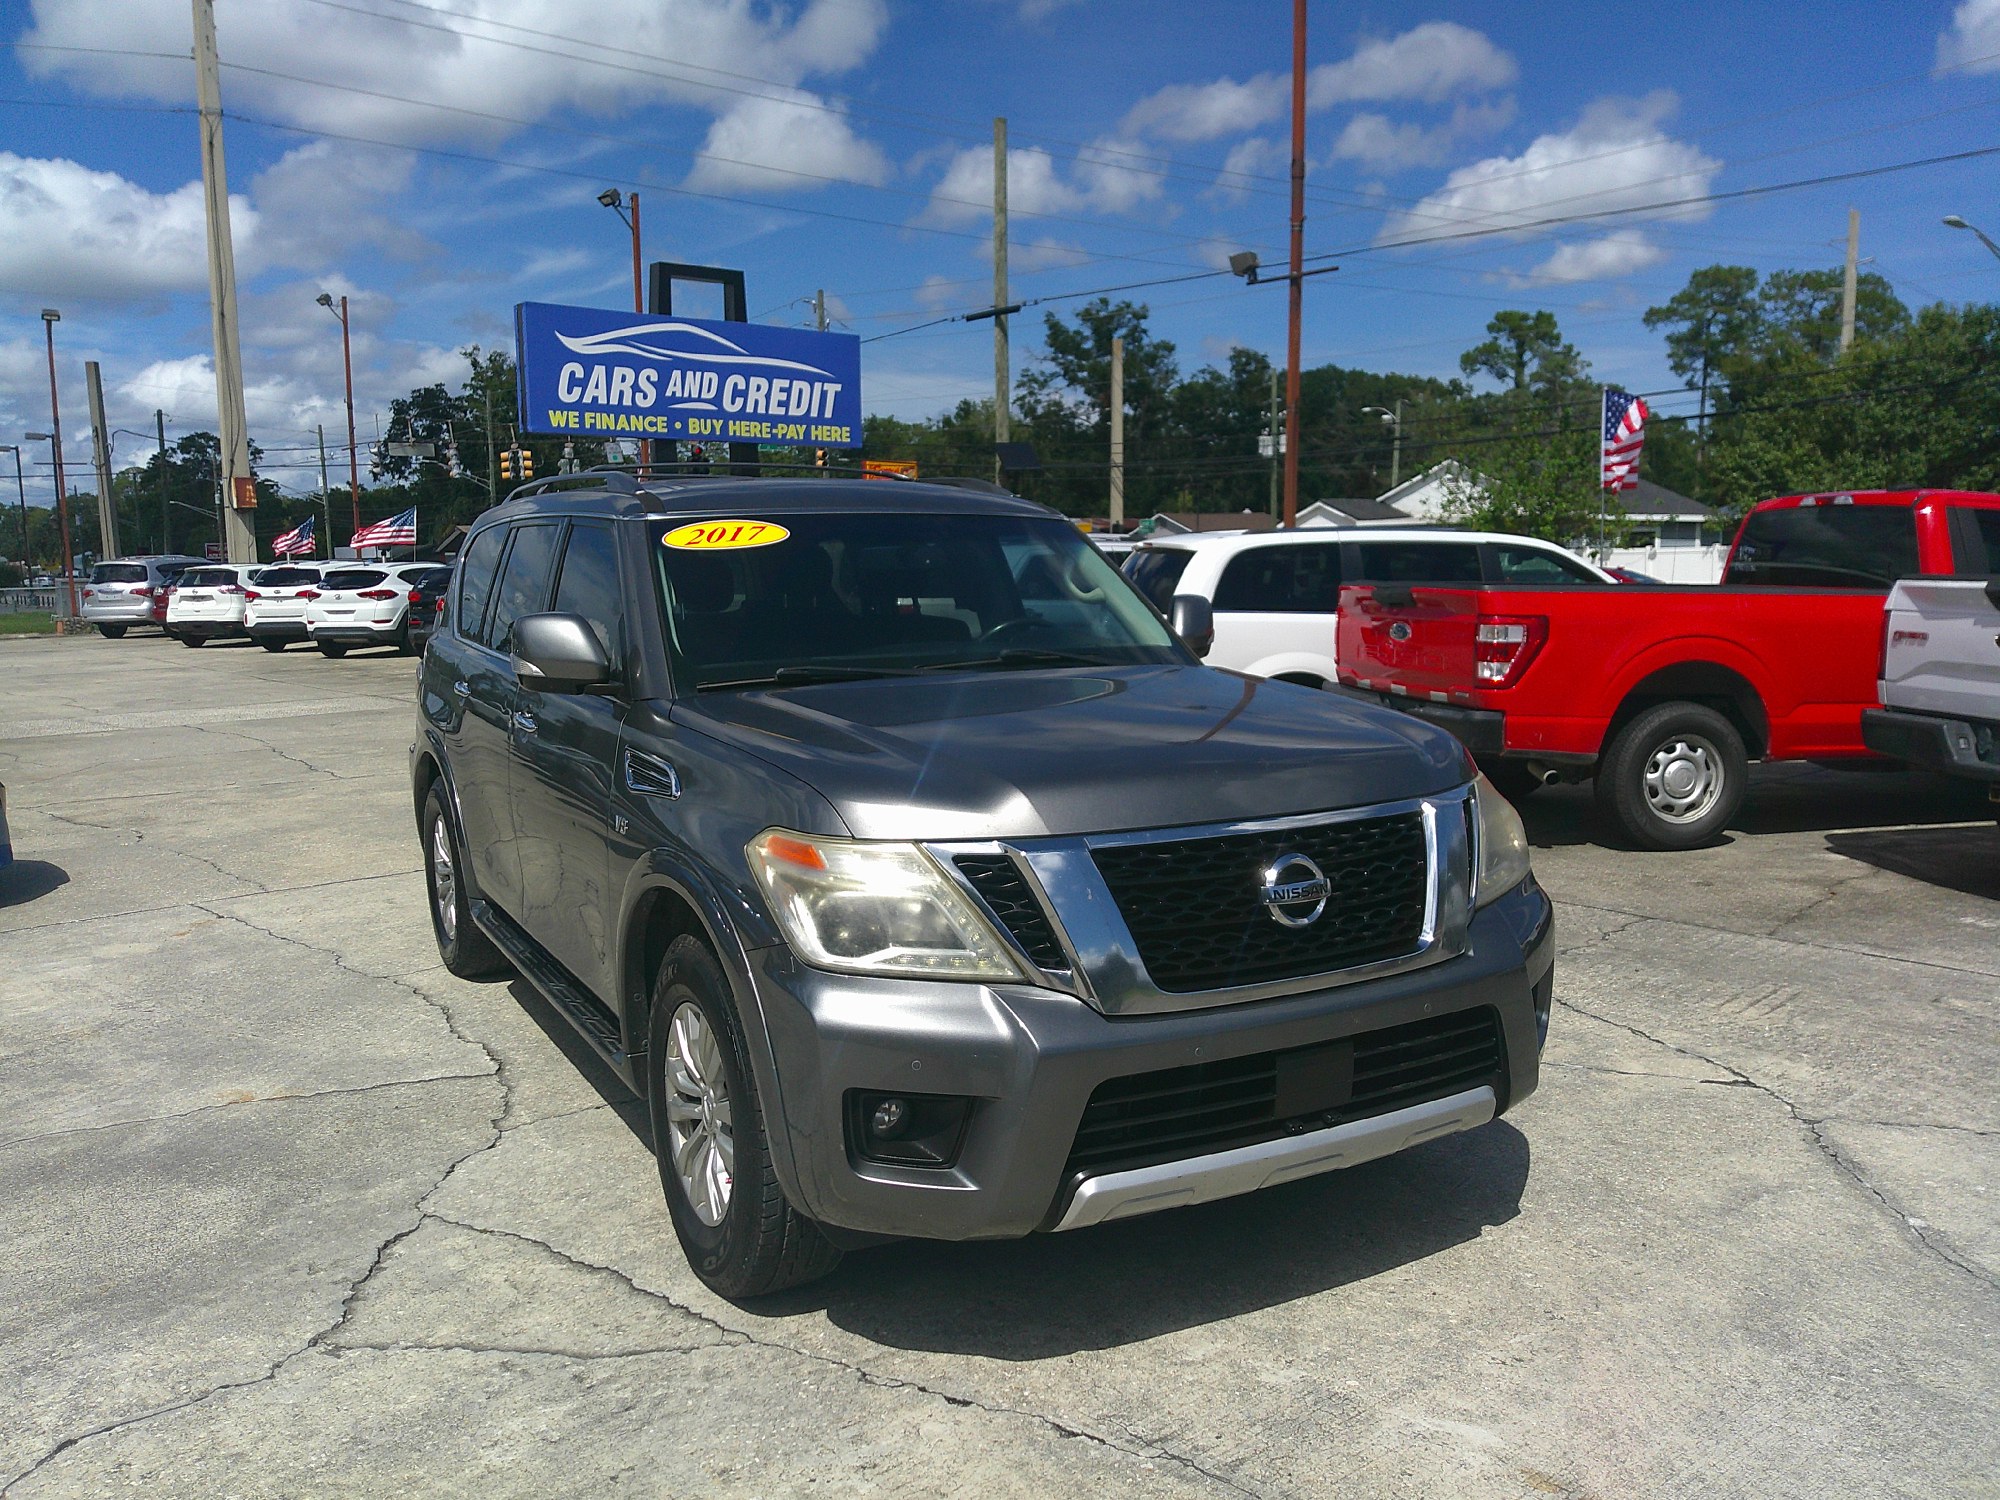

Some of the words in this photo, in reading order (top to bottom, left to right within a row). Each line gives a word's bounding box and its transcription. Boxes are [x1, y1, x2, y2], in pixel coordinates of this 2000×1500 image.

[558, 361, 659, 408] CARS
[665, 369, 719, 399] AND
[722, 373, 842, 419] CREDIT
[548, 409, 580, 429] WE
[584, 411, 668, 433] FINANCE
[688, 417, 724, 436] BUY
[810, 424, 851, 443] HERE
[684, 525, 768, 546] 2017
[1272, 883, 1328, 901] NISSAN
